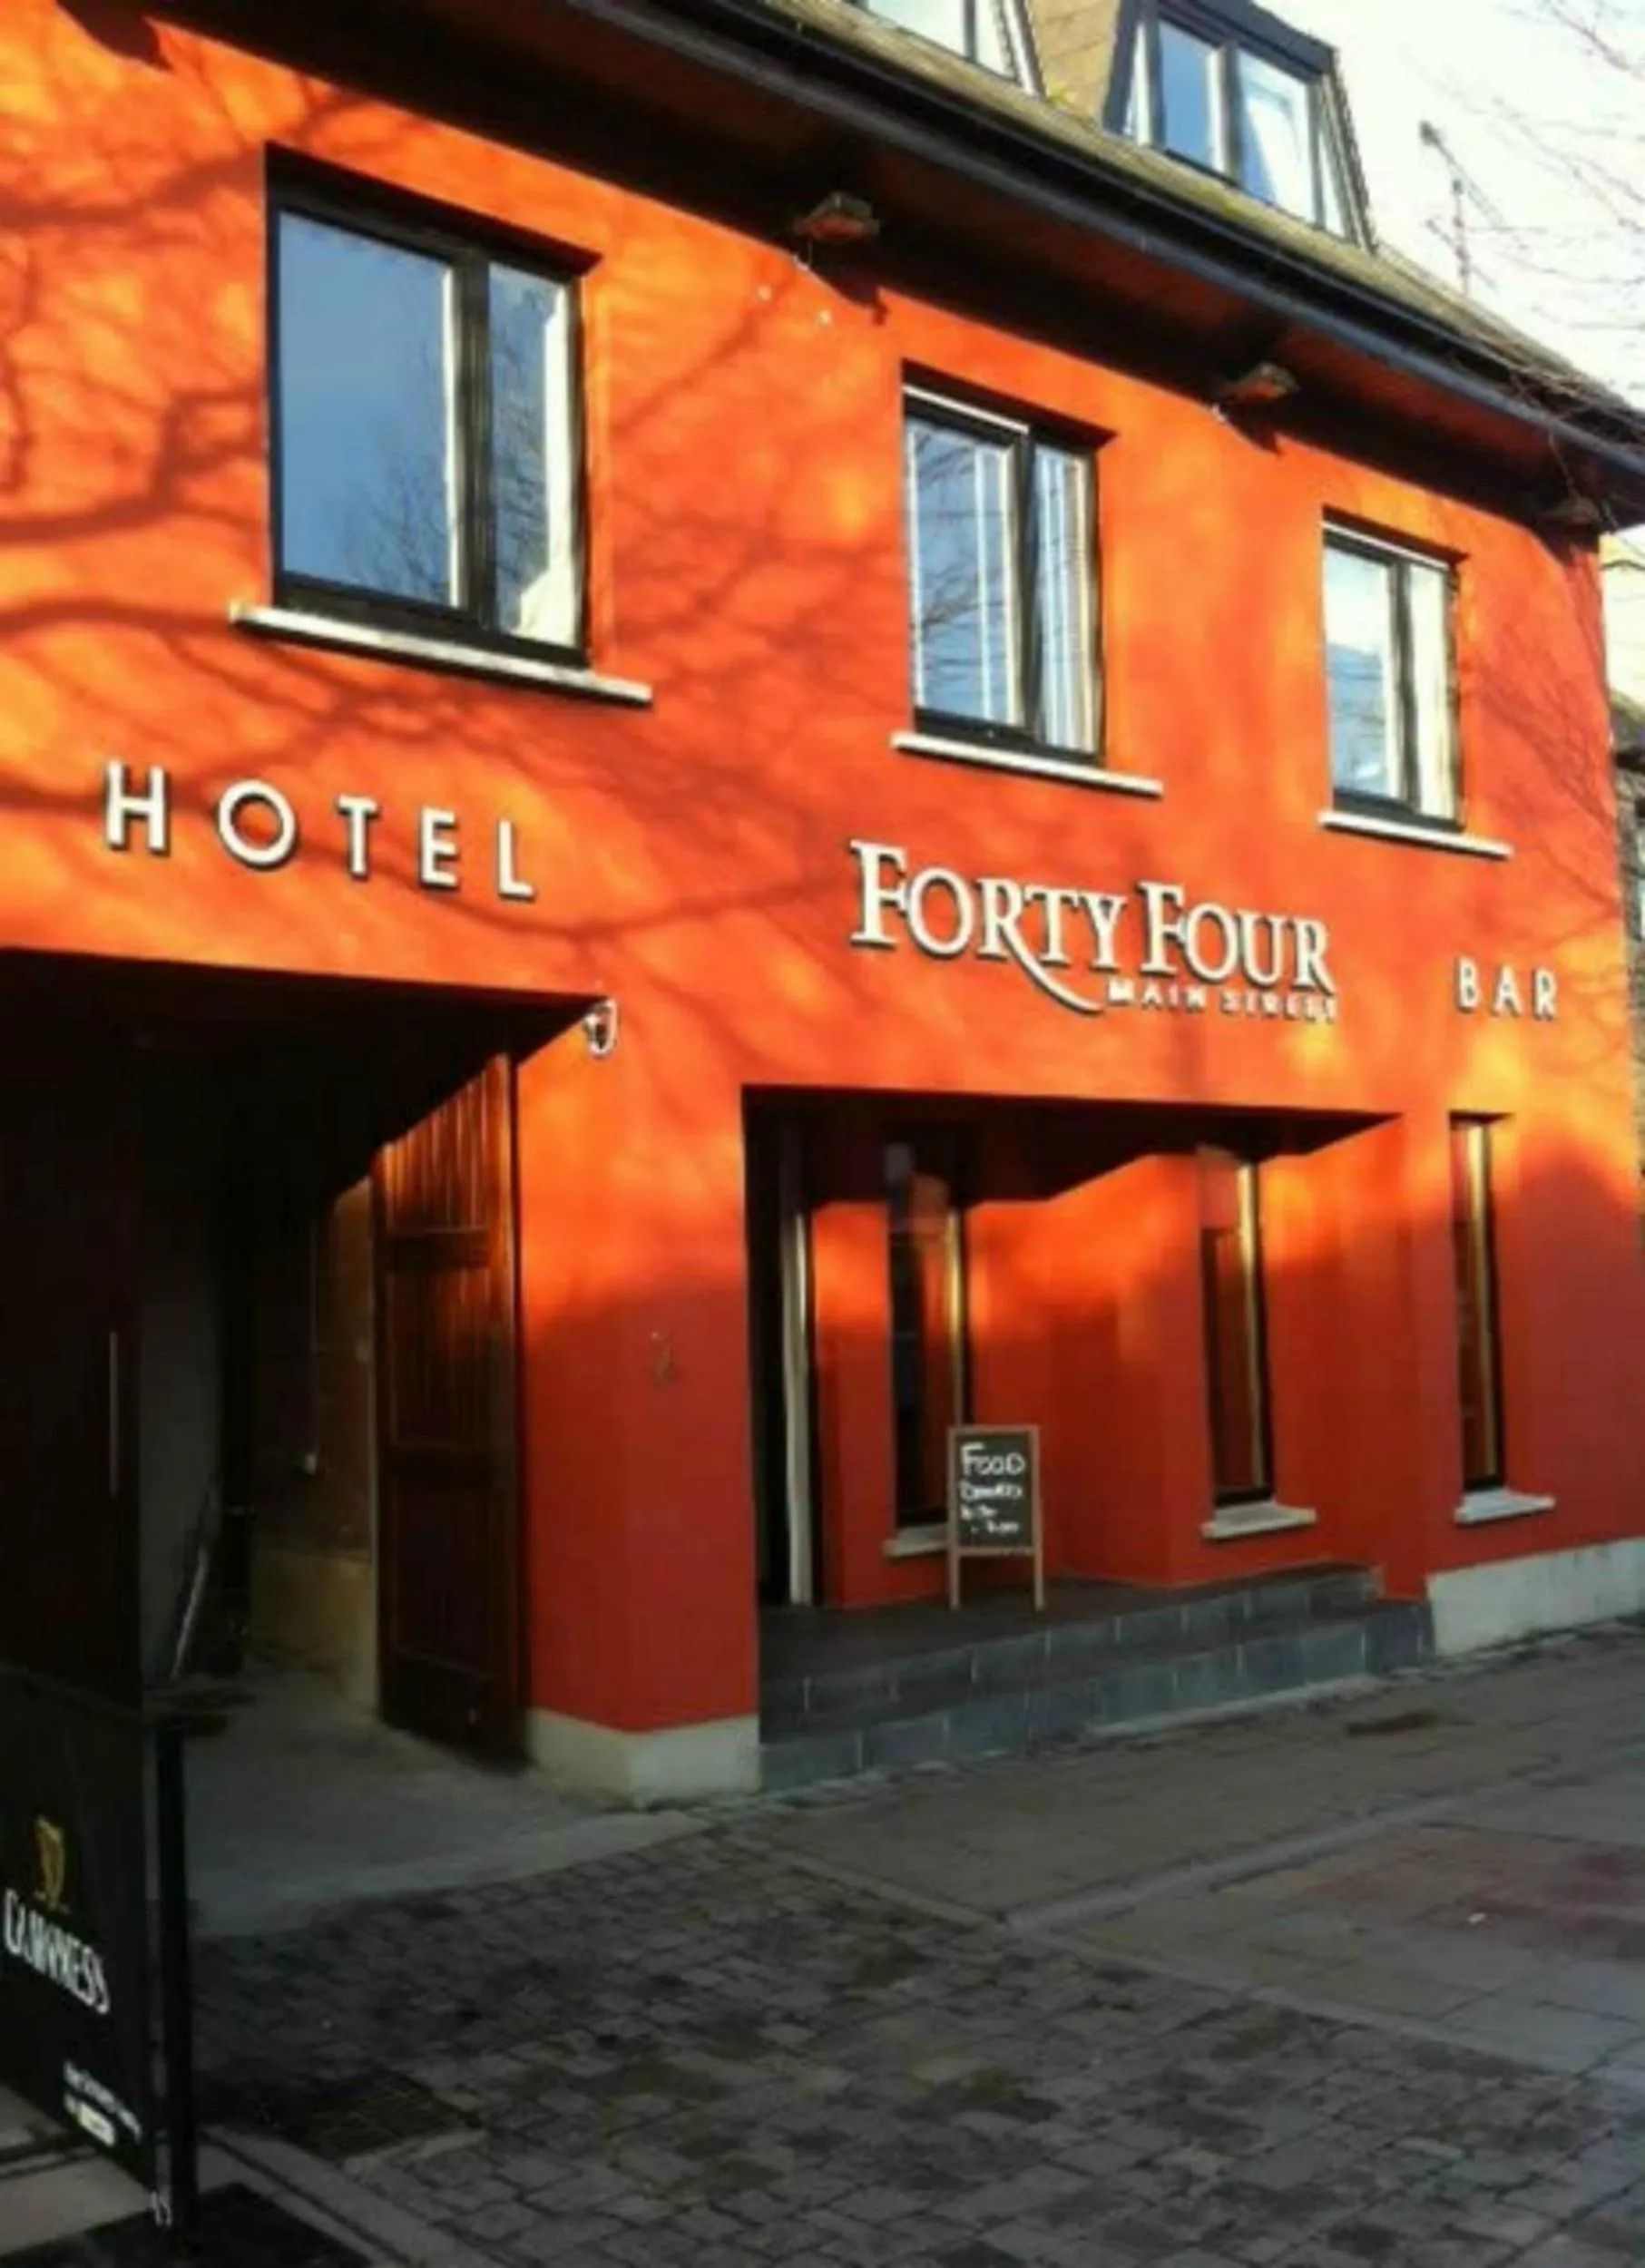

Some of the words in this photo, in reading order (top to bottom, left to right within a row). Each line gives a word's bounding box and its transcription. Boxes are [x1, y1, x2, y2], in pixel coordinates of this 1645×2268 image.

[103, 758, 536, 900] HOTEL
[849, 839, 1125, 1013] FORTY
[1138, 880, 1336, 995] FOUR
[1106, 977, 1207, 1012] MAIN
[1455, 955, 1559, 1020] BAR
[961, 1442, 1025, 1475] FOOD
